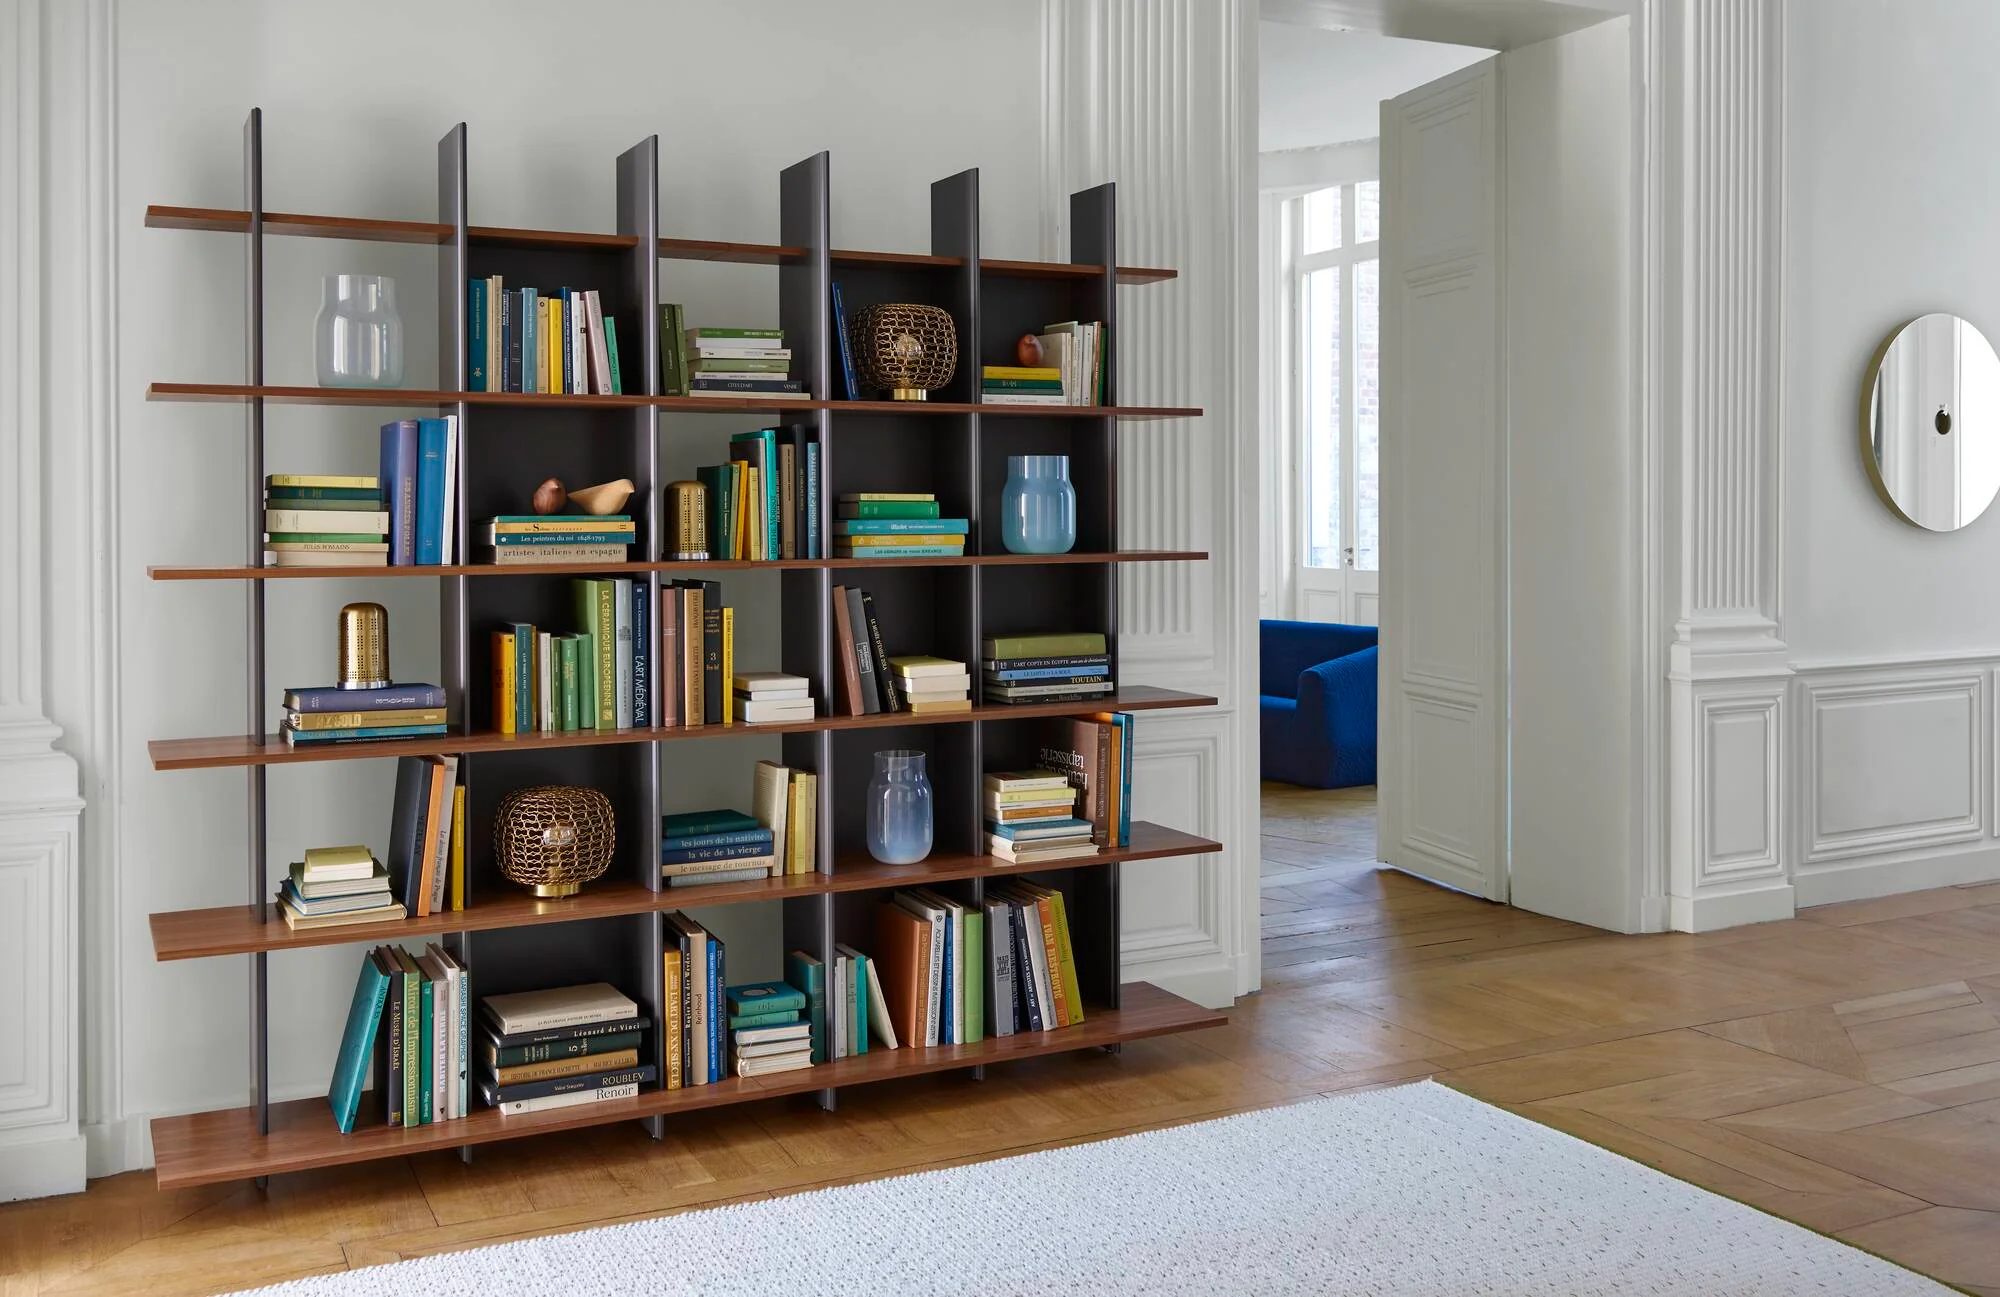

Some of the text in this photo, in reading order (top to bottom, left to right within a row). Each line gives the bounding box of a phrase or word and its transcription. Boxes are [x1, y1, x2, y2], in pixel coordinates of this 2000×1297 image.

[808, 452, 818, 487] chartres
[809, 488, 818, 498] de
[810, 501, 818, 528] monde
[503, 548, 536, 557] artistes
[540, 547, 572, 556] italiens
[590, 548, 623, 556] espagne
[601, 590, 609, 601] LA
[710, 652, 717, 661] 3
[634, 655, 645, 678] L'ART
[1071, 675, 1102, 684] TOUTAIN
[634, 679, 647, 724] MÉDIÉVAL
[1040, 748, 1084, 770] tapisserie
[680, 840, 693, 848] les
[693, 838, 714, 848] jours
[716, 836, 726, 844] de
[727, 835, 736, 843] la
[688, 845, 765, 859] la vie de la vierge
[723, 861, 733, 869] de
[1043, 923, 1054, 946] IVAN
[406, 980, 420, 1014] Miroir
[694, 993, 704, 1025] Reinhoud
[406, 1015, 420, 1029] de
[459, 976, 467, 1063] IGARASHI SPACE GRAPHICS
[573, 1028, 605, 1037] Léonard
[619, 1022, 641, 1031] Vinci
[670, 1021, 679, 1035] DU
[568, 1045, 578, 1053] 5
[602, 1071, 645, 1086] ROUBLEV
[596, 1085, 635, 1100] Renoir
